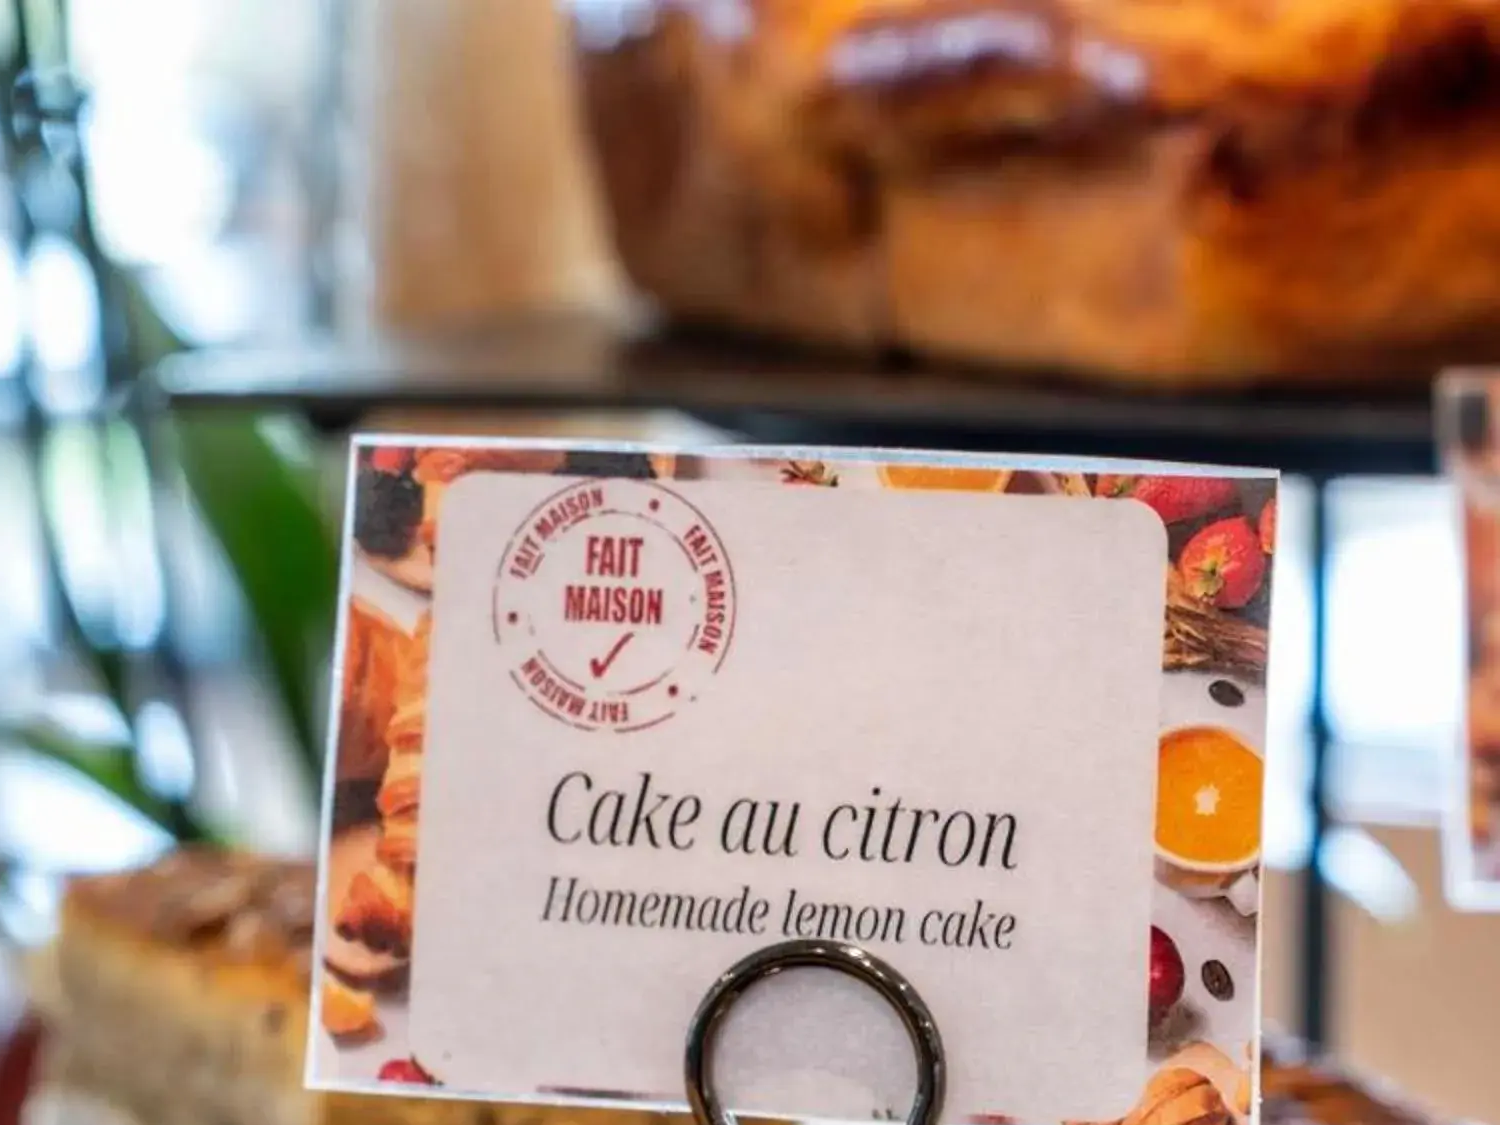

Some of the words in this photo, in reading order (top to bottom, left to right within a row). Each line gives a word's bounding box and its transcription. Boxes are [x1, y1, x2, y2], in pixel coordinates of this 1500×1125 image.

[534, 489, 604, 542] MAISON
[585, 535, 644, 578] FAIT
[683, 524, 718, 569] FAIT
[564, 585, 664, 625] MAISON
[697, 570, 726, 655] MAISON
[521, 657, 587, 716] MAISON
[589, 701, 629, 722] FAIT
[546, 770, 702, 851] Cake
[720, 797, 801, 857] au
[822, 787, 1018, 870] citron
[540, 875, 770, 935] Homemade
[781, 889, 906, 943] lemon
[918, 900, 1017, 950] cake
